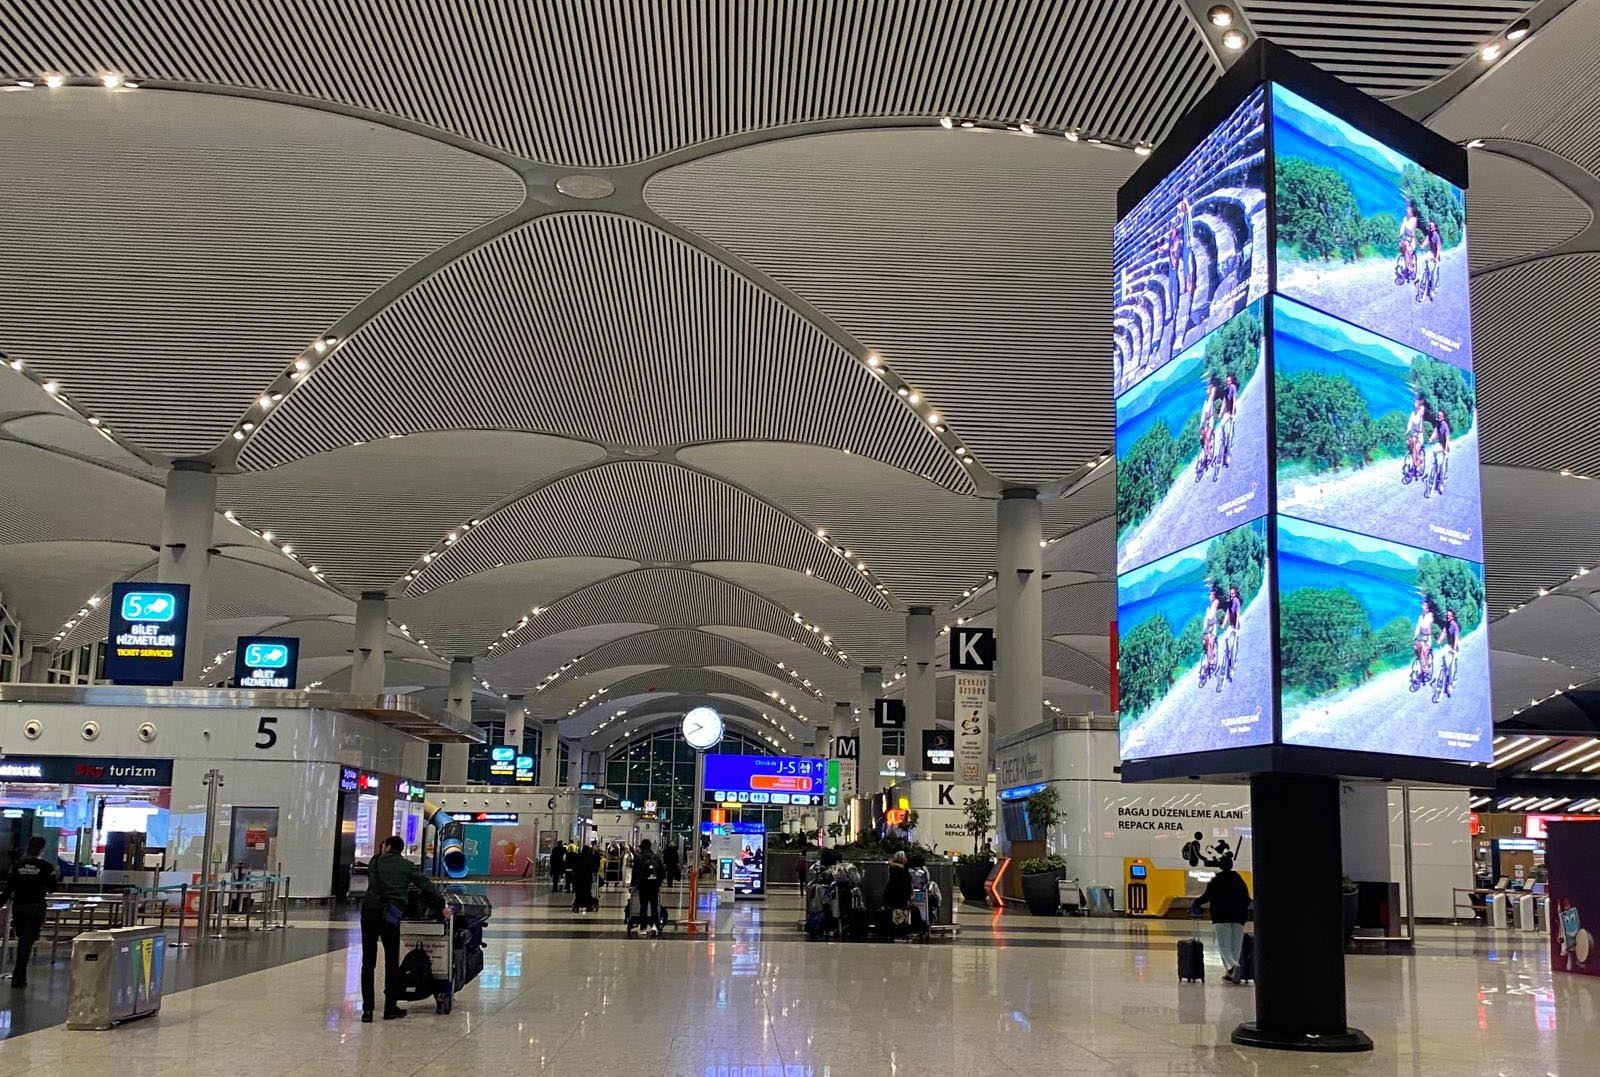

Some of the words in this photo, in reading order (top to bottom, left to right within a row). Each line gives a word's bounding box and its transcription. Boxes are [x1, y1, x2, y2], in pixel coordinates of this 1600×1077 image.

[128, 596, 142, 617] 5
[131, 624, 160, 635] BİLET
[116, 634, 176, 646] HİZMETLERİ
[251, 647, 261, 664] 5
[959, 633, 983, 665] K
[882, 702, 896, 725] L
[254, 717, 278, 749] 5
[838, 738, 856, 756] M
[777, 760, 796, 774] J-S
[931, 757, 951, 765] CLASS
[109, 764, 156, 777] turizm
[938, 784, 955, 806] K
[1118, 807, 1150, 817] BAGAJ
[1151, 807, 1212, 819] DÜZENLEME
[1213, 811, 1243, 819] ALANI
[1118, 821, 1156, 830] REPACK
[1157, 822, 1184, 831] AREA
[1512, 826, 1523, 834] J3
